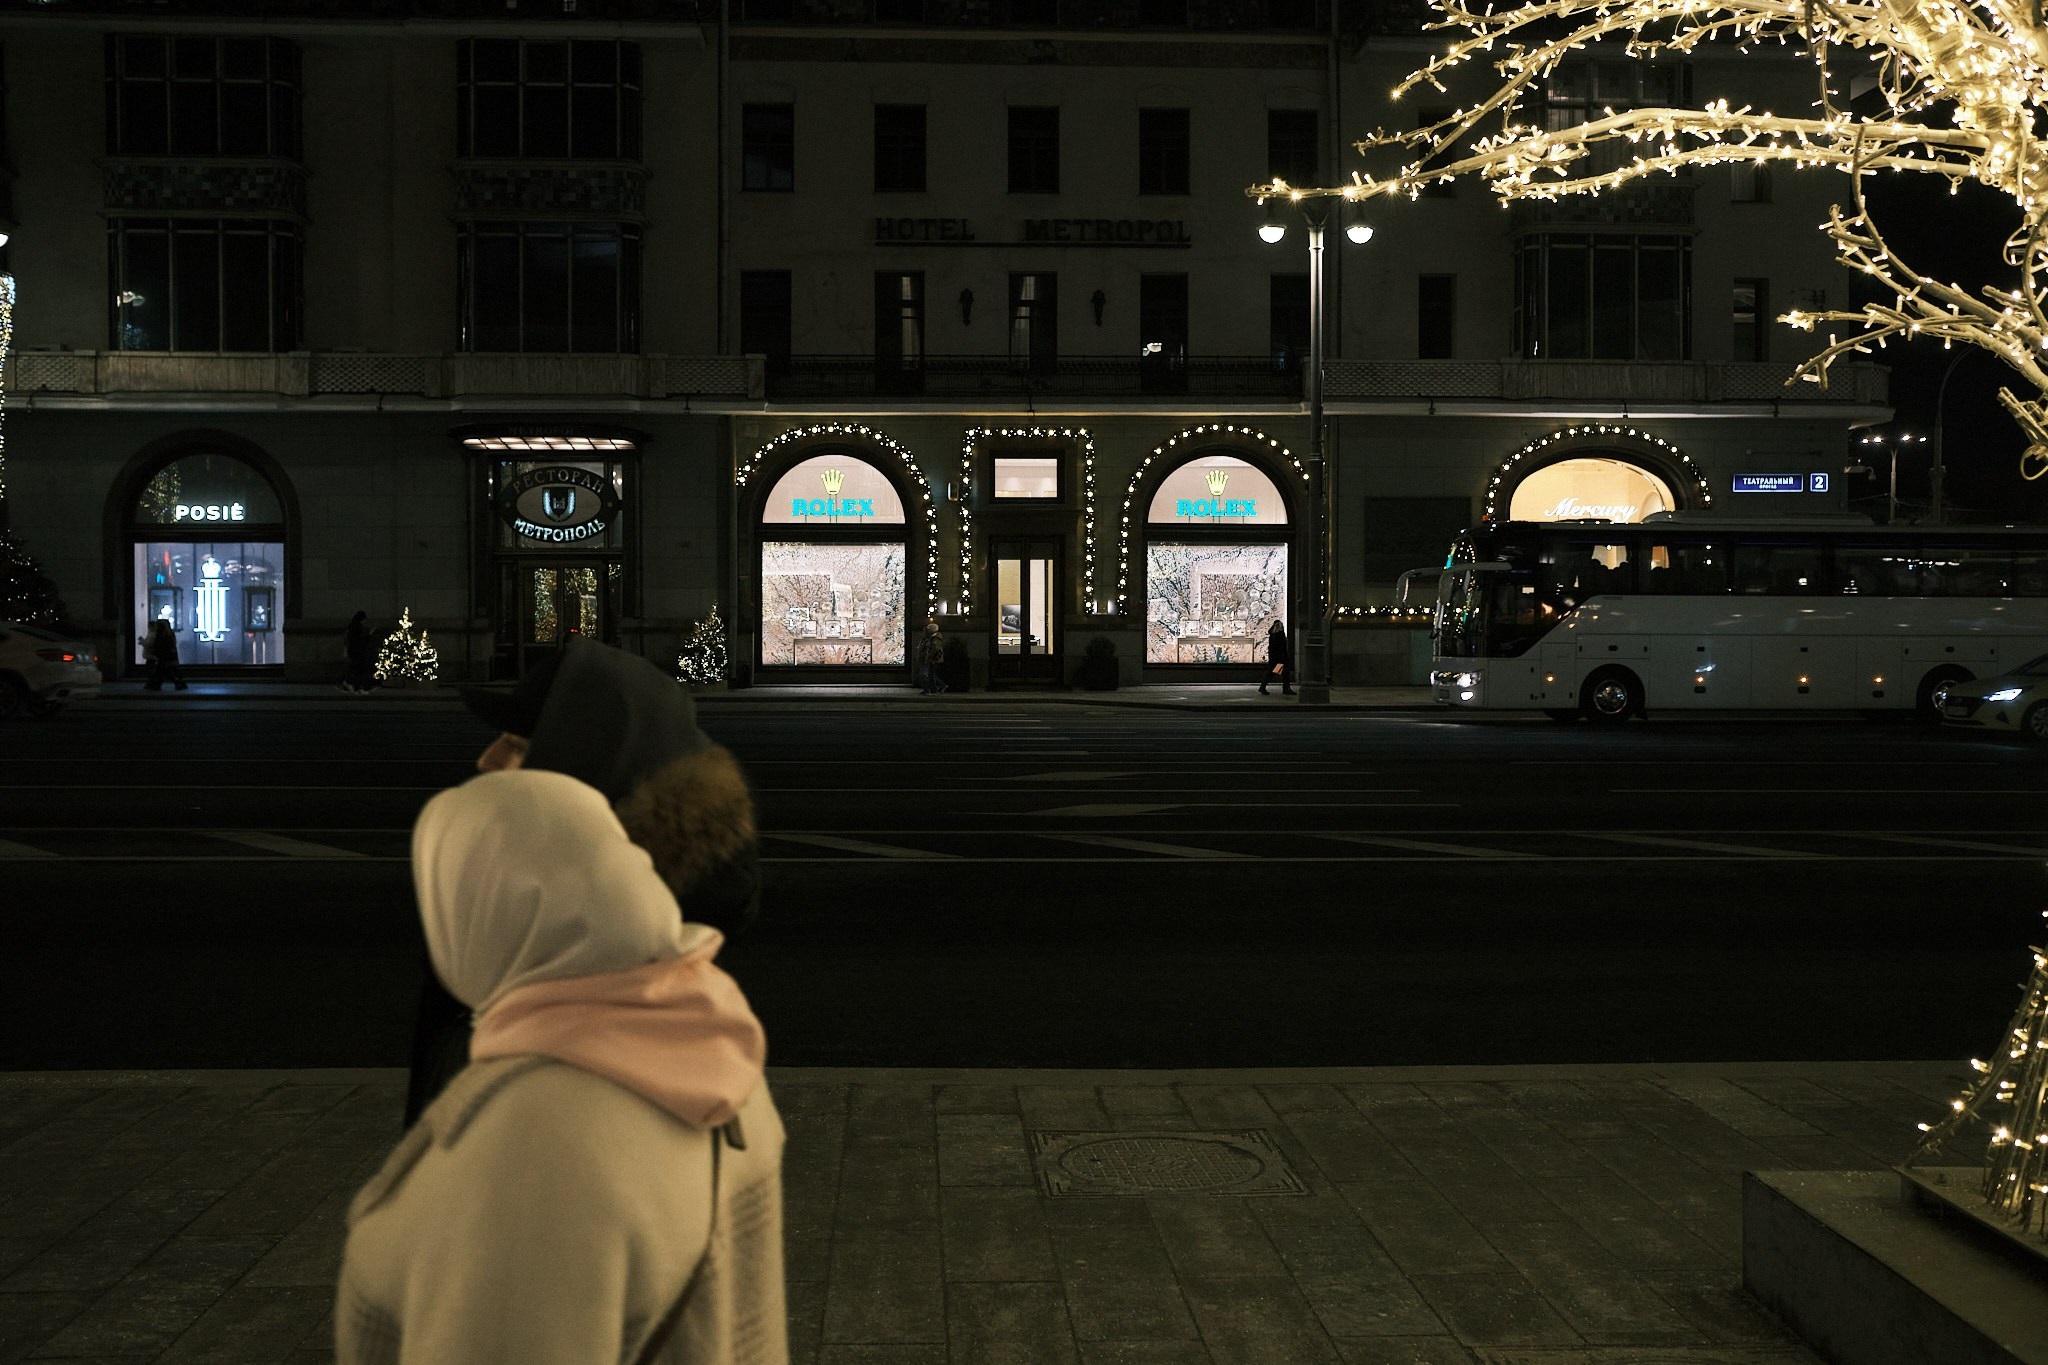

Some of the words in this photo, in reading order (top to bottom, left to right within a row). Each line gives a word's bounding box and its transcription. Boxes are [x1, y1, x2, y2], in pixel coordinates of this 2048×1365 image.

[876, 218, 975, 241] HOTEL
[1023, 219, 1191, 242] METROPOL
[513, 469, 605, 494] РЕСТОРАН
[1743, 476, 1794, 485] ТЕАТРАЛЬНЫЙ
[1815, 476, 1824, 489] 2
[792, 499, 875, 516] ROLEX
[1176, 499, 1258, 517] ROLEX
[1544, 498, 1637, 523] Mercury
[513, 517, 606, 542] МЕТРОПОЛЬ
